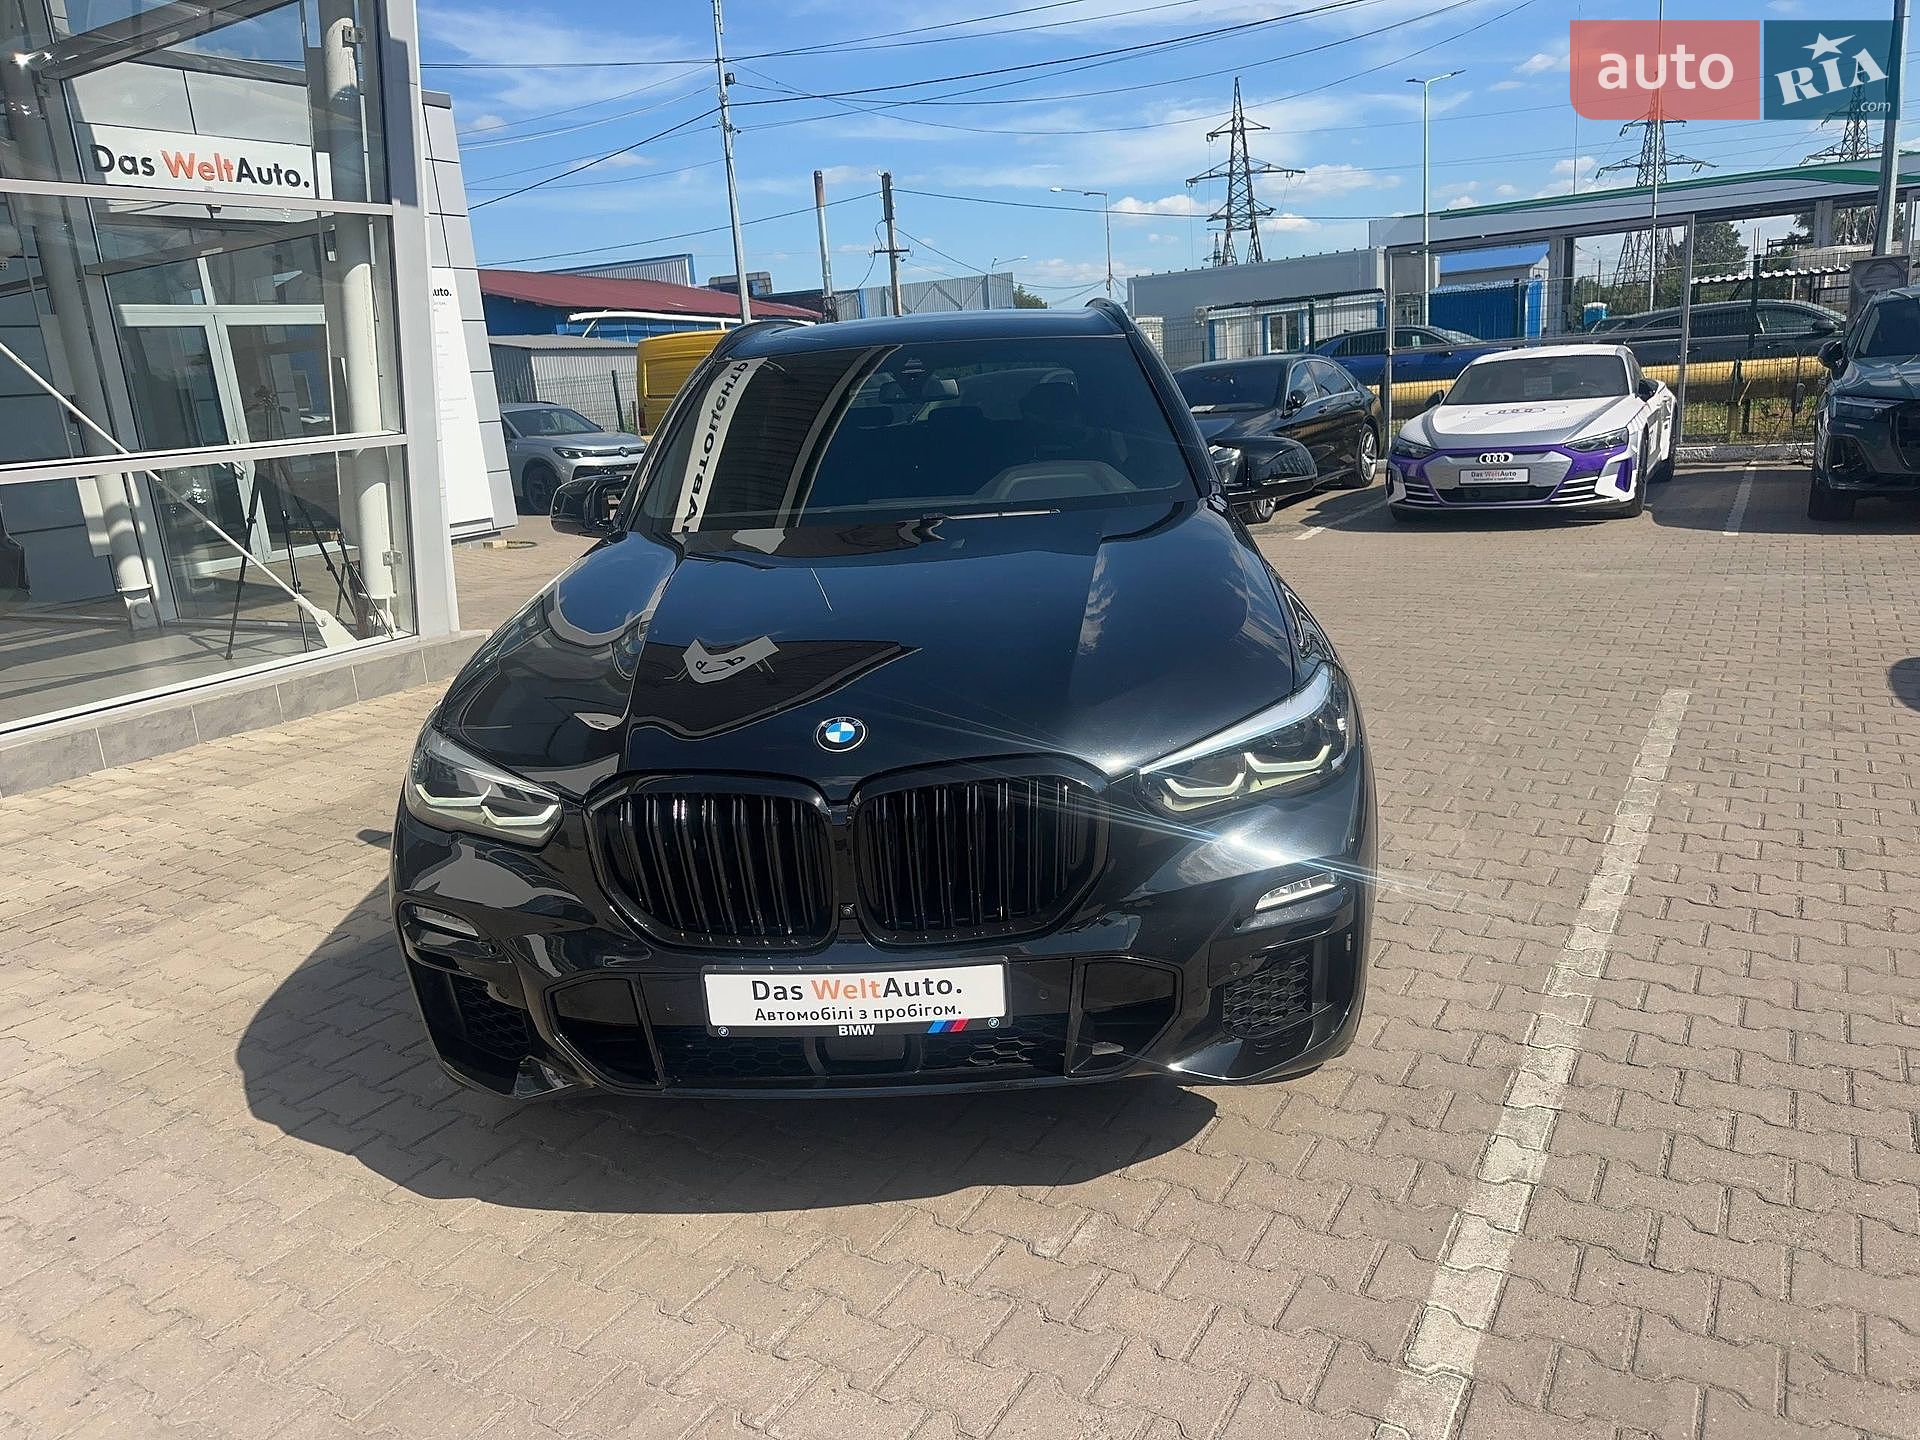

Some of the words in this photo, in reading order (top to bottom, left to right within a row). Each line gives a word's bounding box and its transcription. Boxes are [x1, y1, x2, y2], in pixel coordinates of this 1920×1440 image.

[89, 144, 155, 176] Das
[161, 149, 310, 189] WeltAuto.
[432, 287, 452, 297] uto.
[751, 979, 803, 1002] Das
[811, 976, 963, 1000] WeltAuto.
[754, 1006, 853, 1021] Автомобілі
[860, 1010, 868, 1020] з
[873, 1004, 962, 1023] пробігом.
[838, 1024, 876, 1036] BMW
